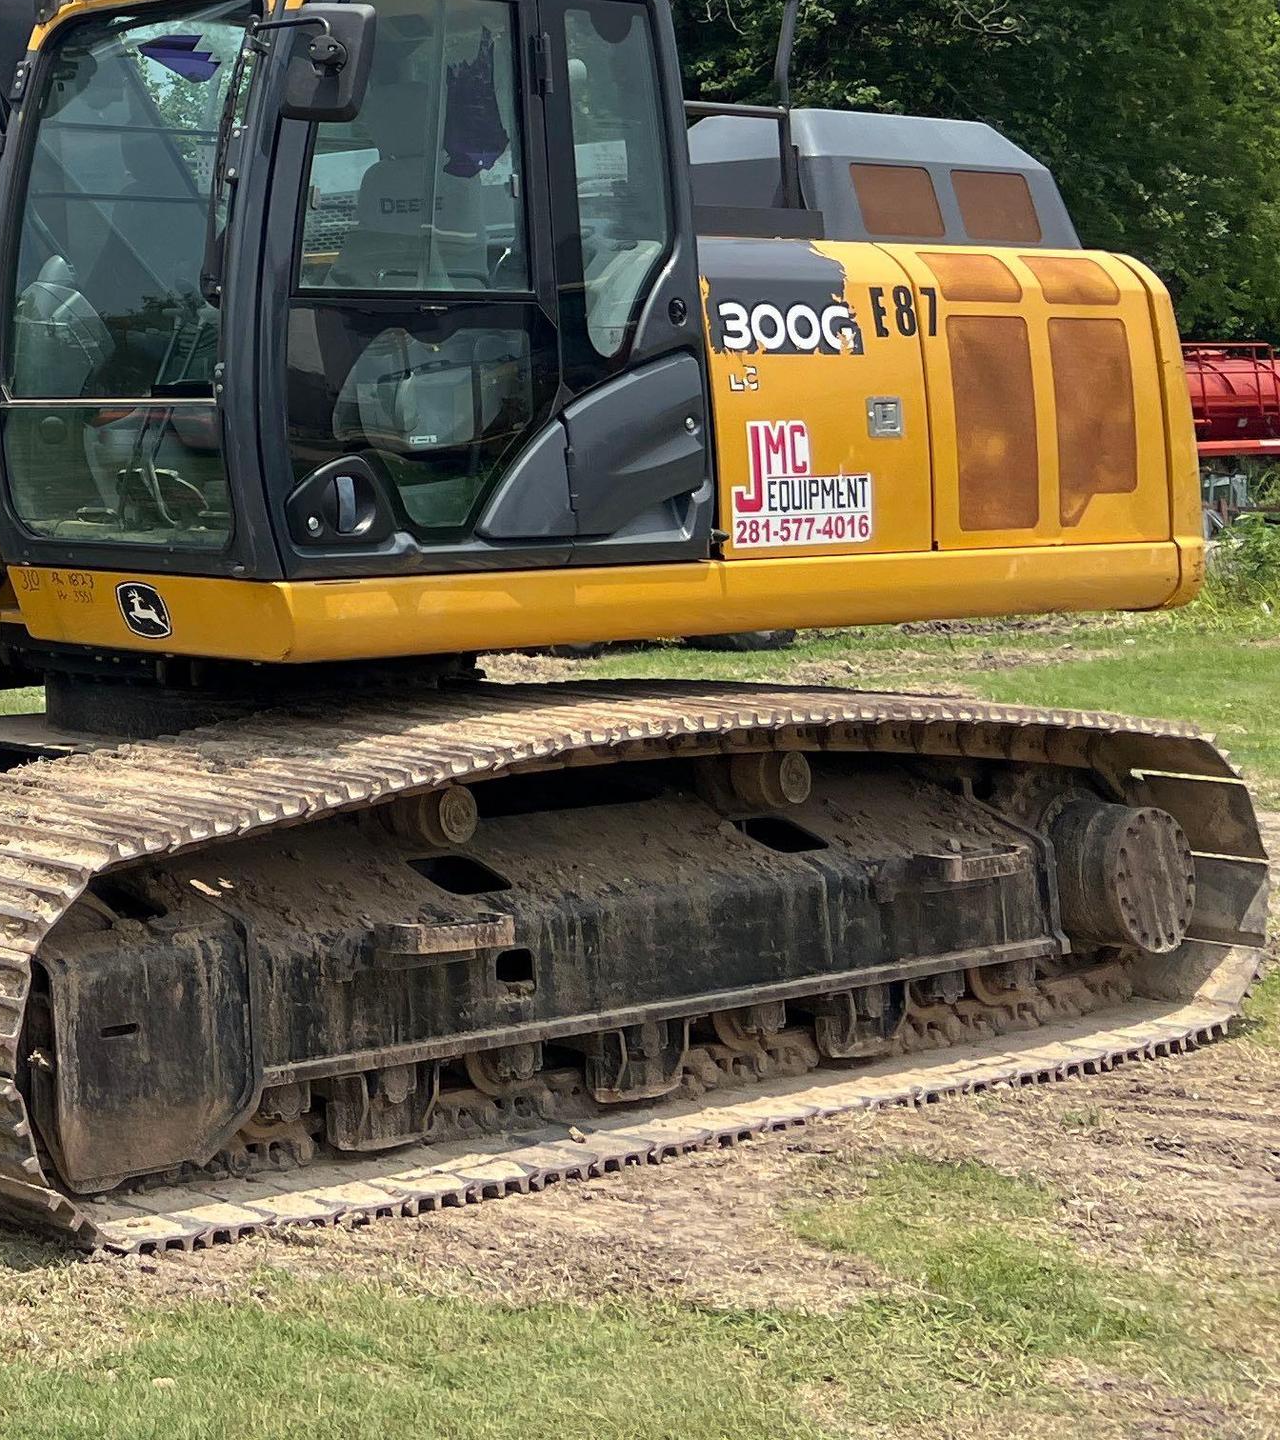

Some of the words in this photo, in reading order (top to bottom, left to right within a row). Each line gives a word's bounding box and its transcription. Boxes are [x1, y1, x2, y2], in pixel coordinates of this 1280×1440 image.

[379, 196, 443, 214] DEEE
[717, 301, 856, 351] 300G
[728, 365, 760, 392] LC
[734, 424, 808, 513] JMC
[767, 477, 870, 513] EQUIPMENT
[735, 514, 870, 545] 281-577-4016
